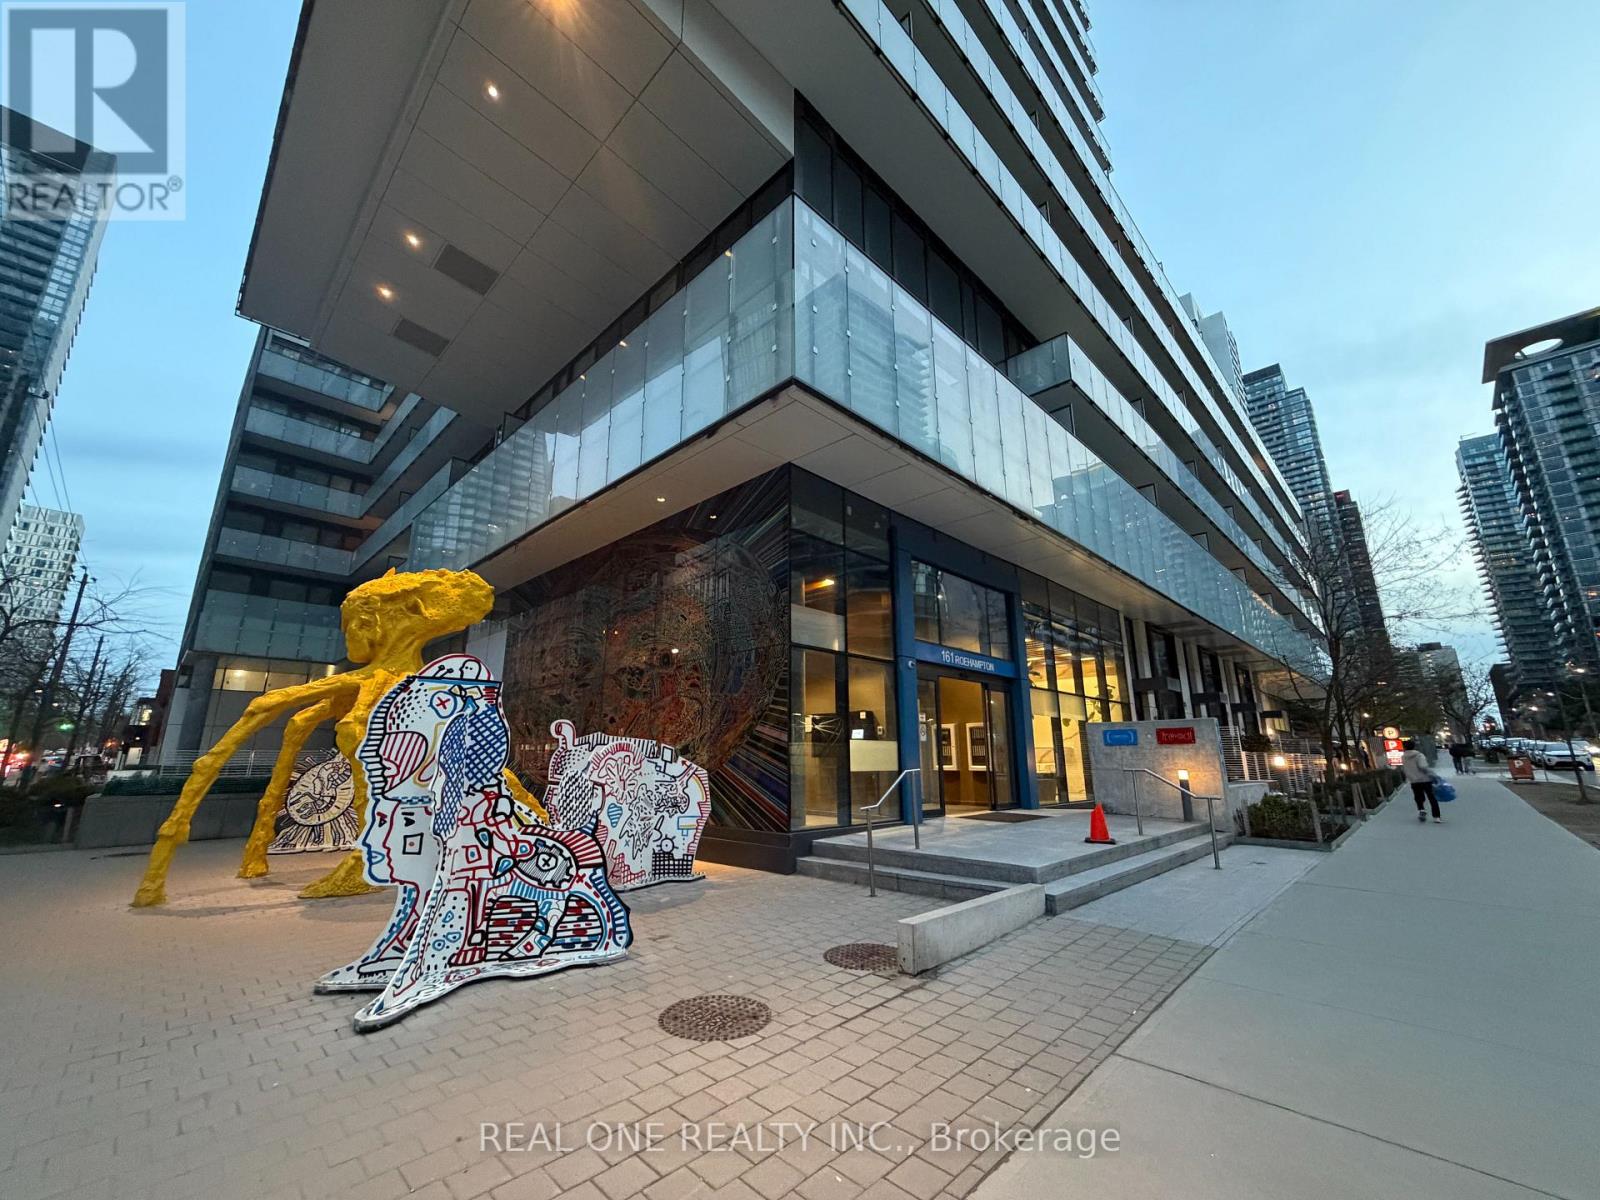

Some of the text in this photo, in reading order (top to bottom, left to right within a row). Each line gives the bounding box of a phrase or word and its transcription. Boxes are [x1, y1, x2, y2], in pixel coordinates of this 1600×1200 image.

[941, 650, 995, 672] 161 ROEHAMPTON
[1388, 740, 1398, 750] P
[1514, 760, 1524, 769] P
